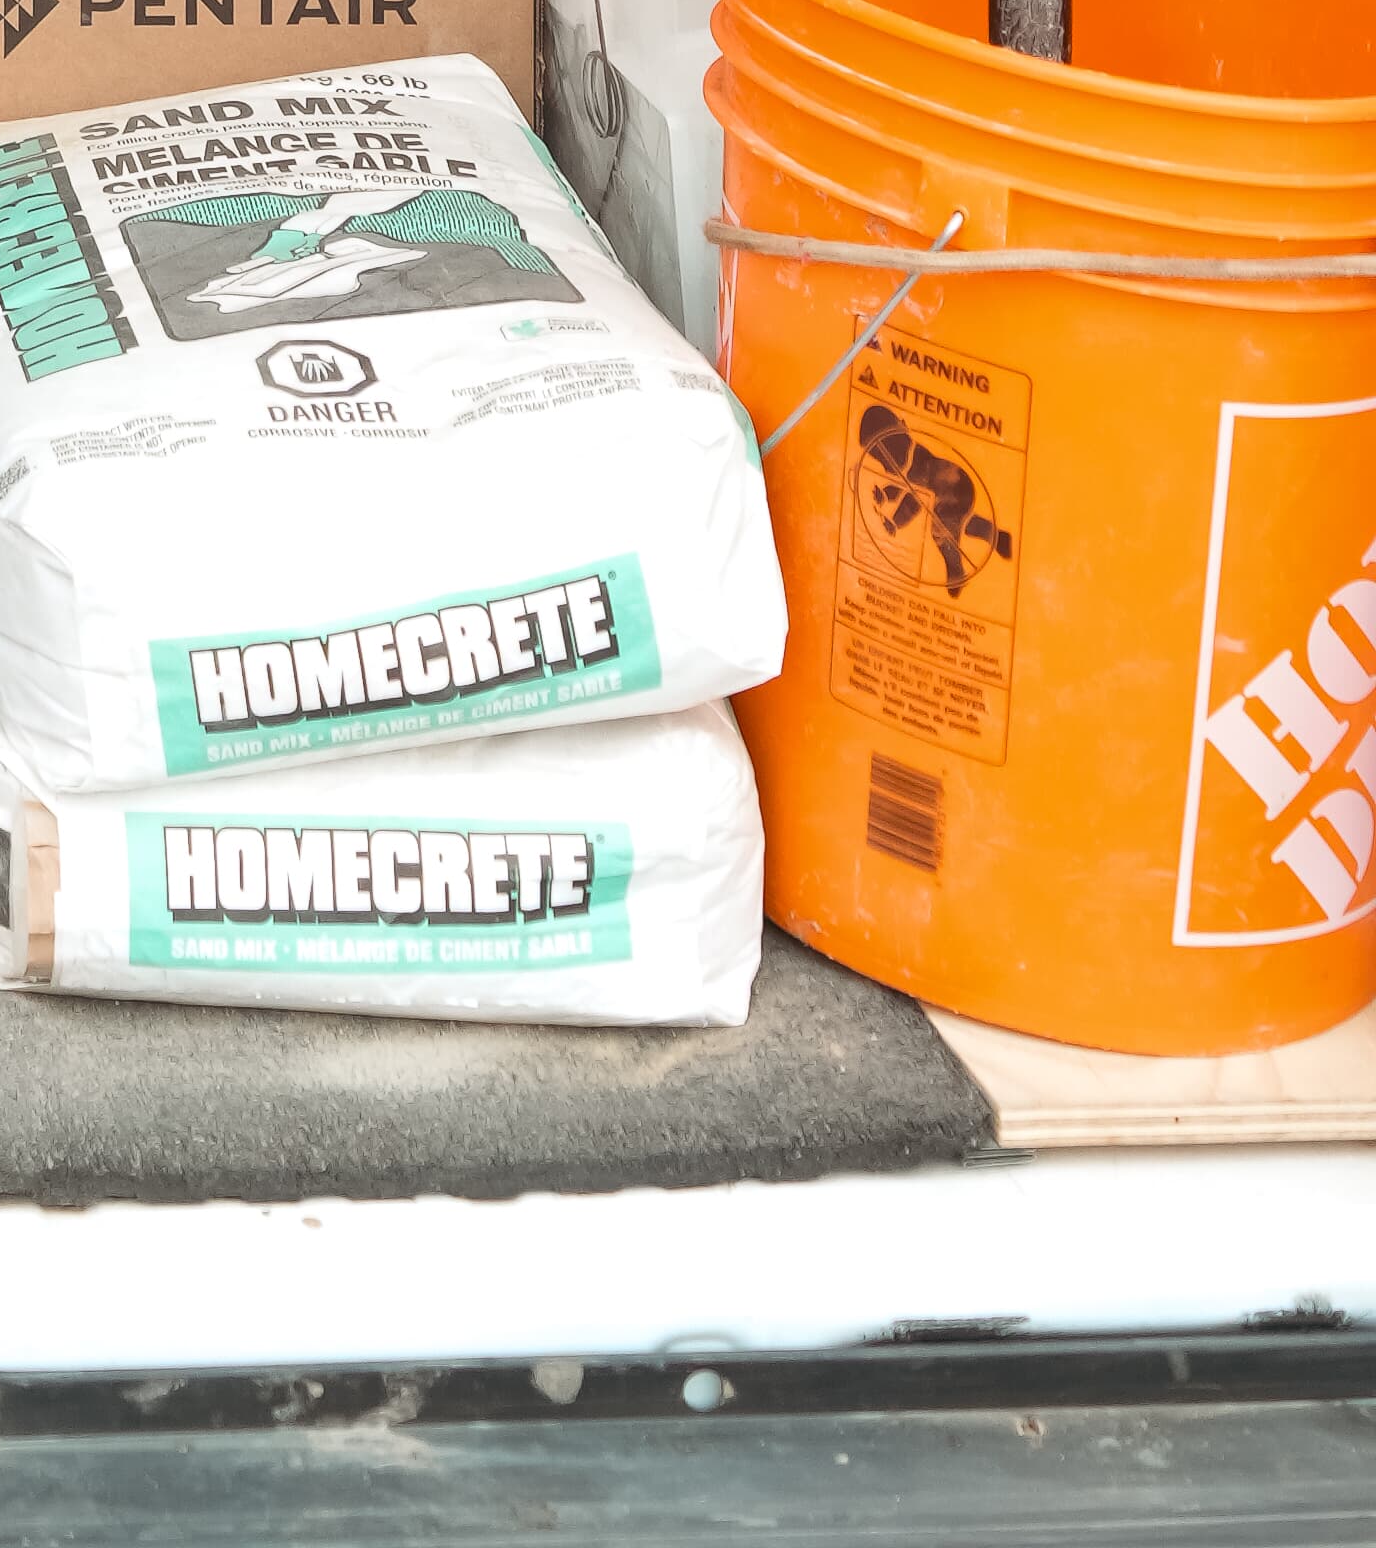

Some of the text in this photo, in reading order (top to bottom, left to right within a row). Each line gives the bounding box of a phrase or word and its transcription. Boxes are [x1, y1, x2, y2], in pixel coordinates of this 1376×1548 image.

[362, 74, 396, 87] 66
[402, 75, 429, 90] lb
[80, 96, 405, 141] SAND MIX
[352, 131, 431, 153] DE
[363, 170, 454, 190] réparation
[890, 340, 991, 395] WARNING
[267, 401, 398, 423] DANGER
[888, 380, 1003, 437] ATTENTION
[247, 427, 432, 439] CORROSIVE CORROSIF
[188, 574, 620, 734] HOMECRETE
[206, 673, 624, 764] SAND MIX MÉLANGE DE CIMENT SABLE
[163, 826, 596, 926] HOMECRETE
[170, 931, 593, 963] SAND MIX MÉLANGE DE CIMENT SABLE
